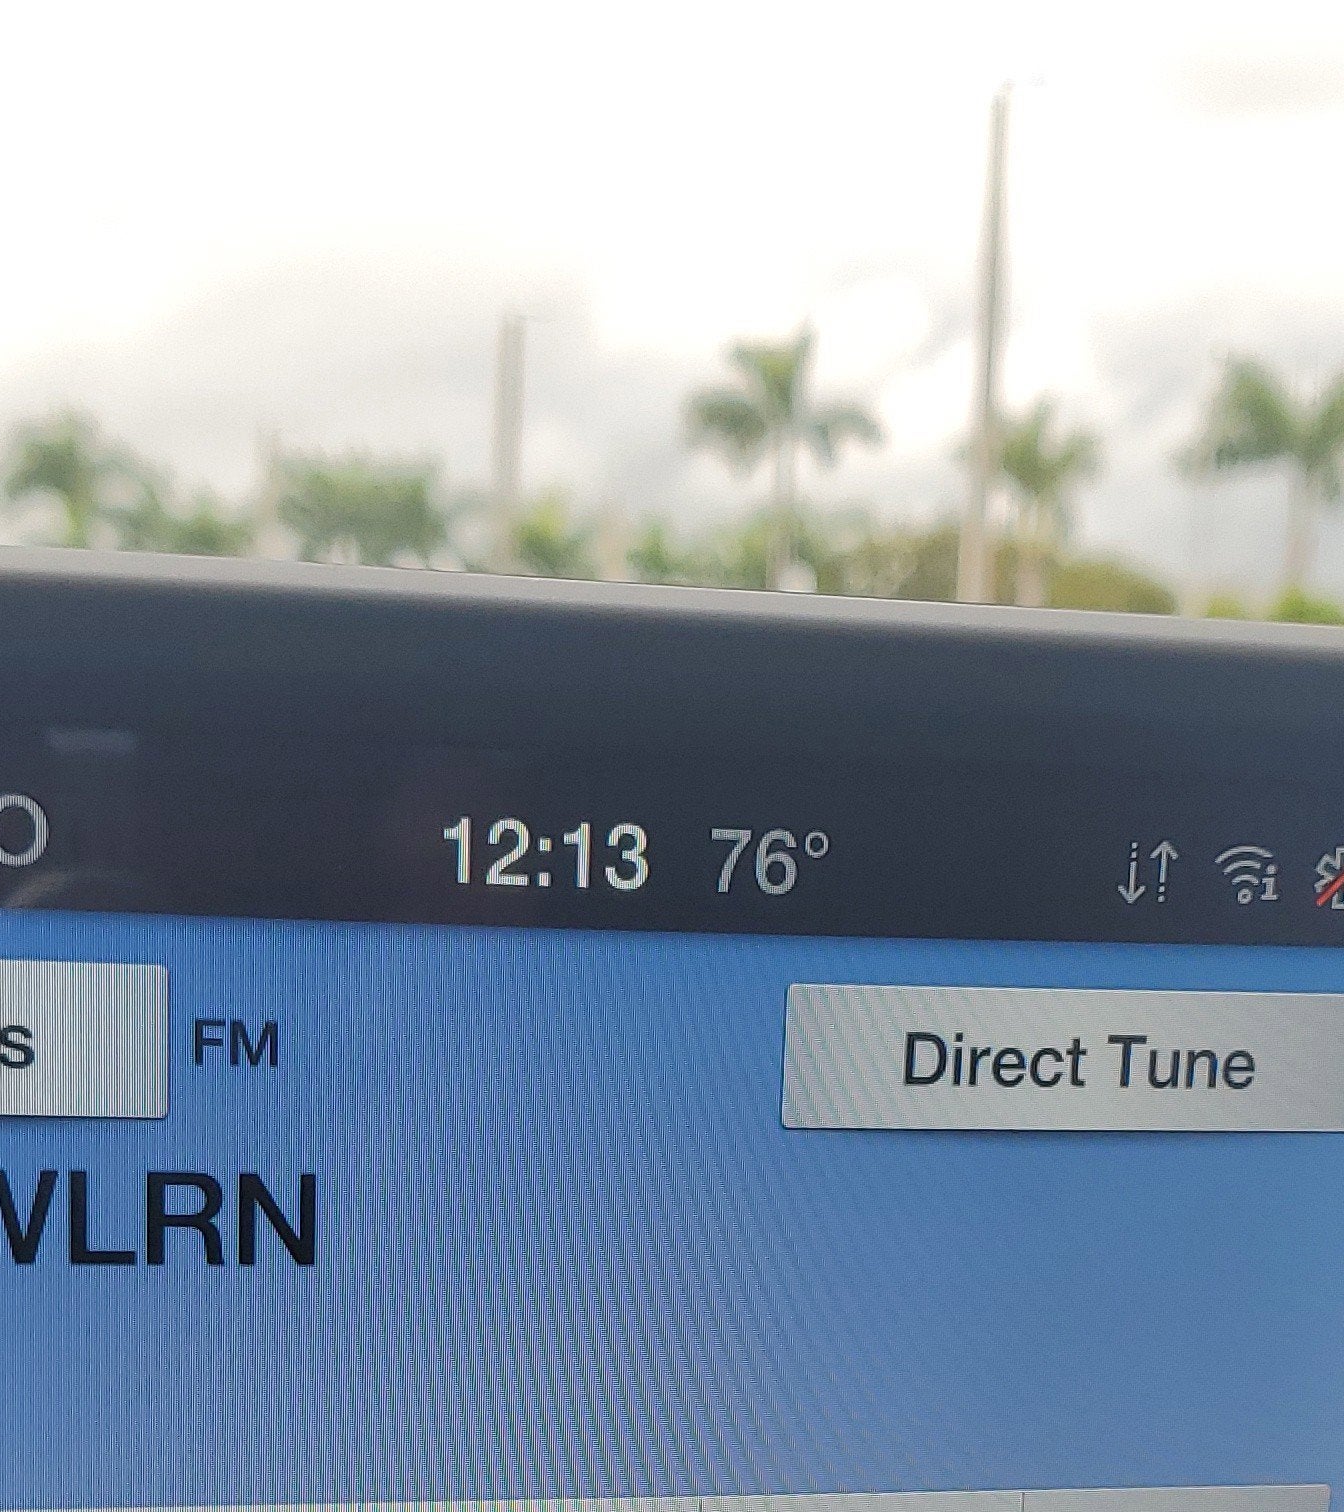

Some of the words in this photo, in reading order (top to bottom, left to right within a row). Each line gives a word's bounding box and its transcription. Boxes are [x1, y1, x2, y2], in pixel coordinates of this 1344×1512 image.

[442, 815, 650, 892] 12:13
[193, 1019, 280, 1068] FM
[903, 1031, 1086, 1088] Direct
[1108, 1035, 1257, 1092] Tune
